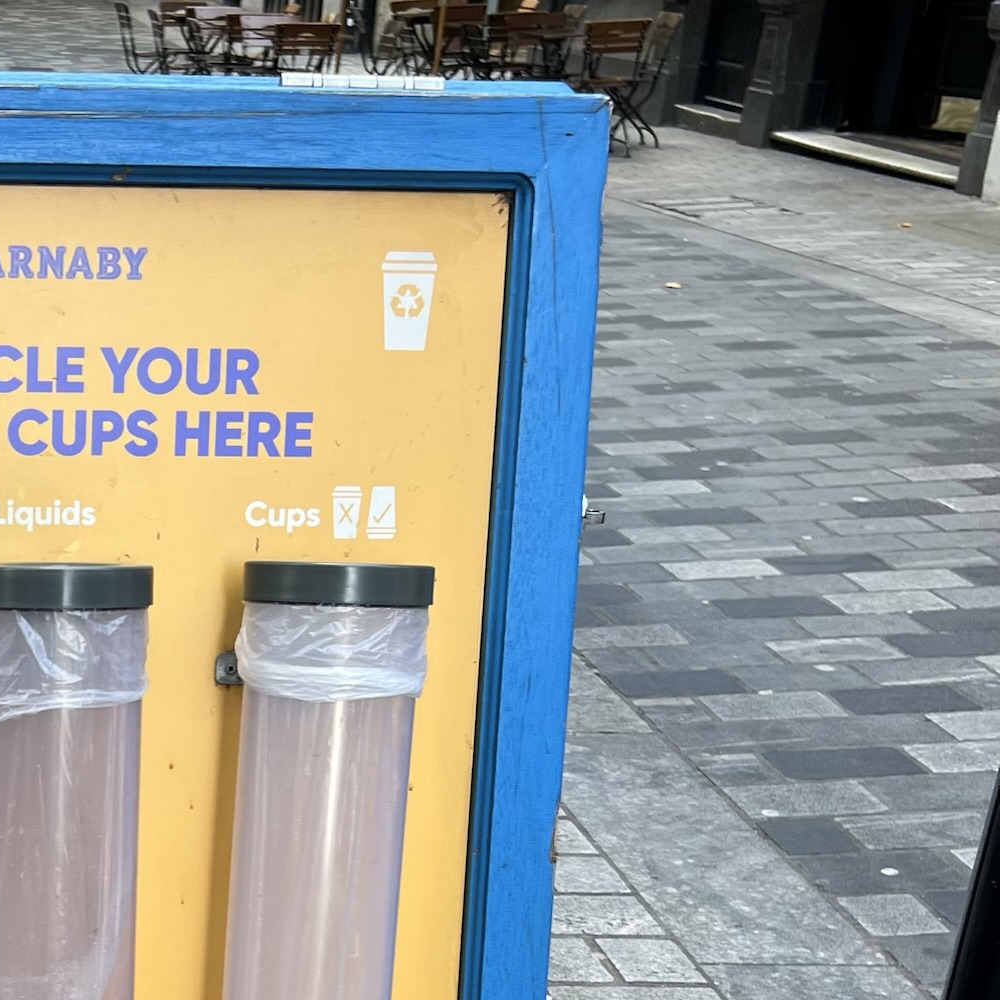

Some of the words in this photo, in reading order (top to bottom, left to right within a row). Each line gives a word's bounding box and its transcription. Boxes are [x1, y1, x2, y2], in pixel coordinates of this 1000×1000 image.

[101, 346, 259, 395] YOUR
[7, 408, 157, 457] CUPS
[174, 410, 314, 458] HERE
[244, 500, 321, 533] Cups
